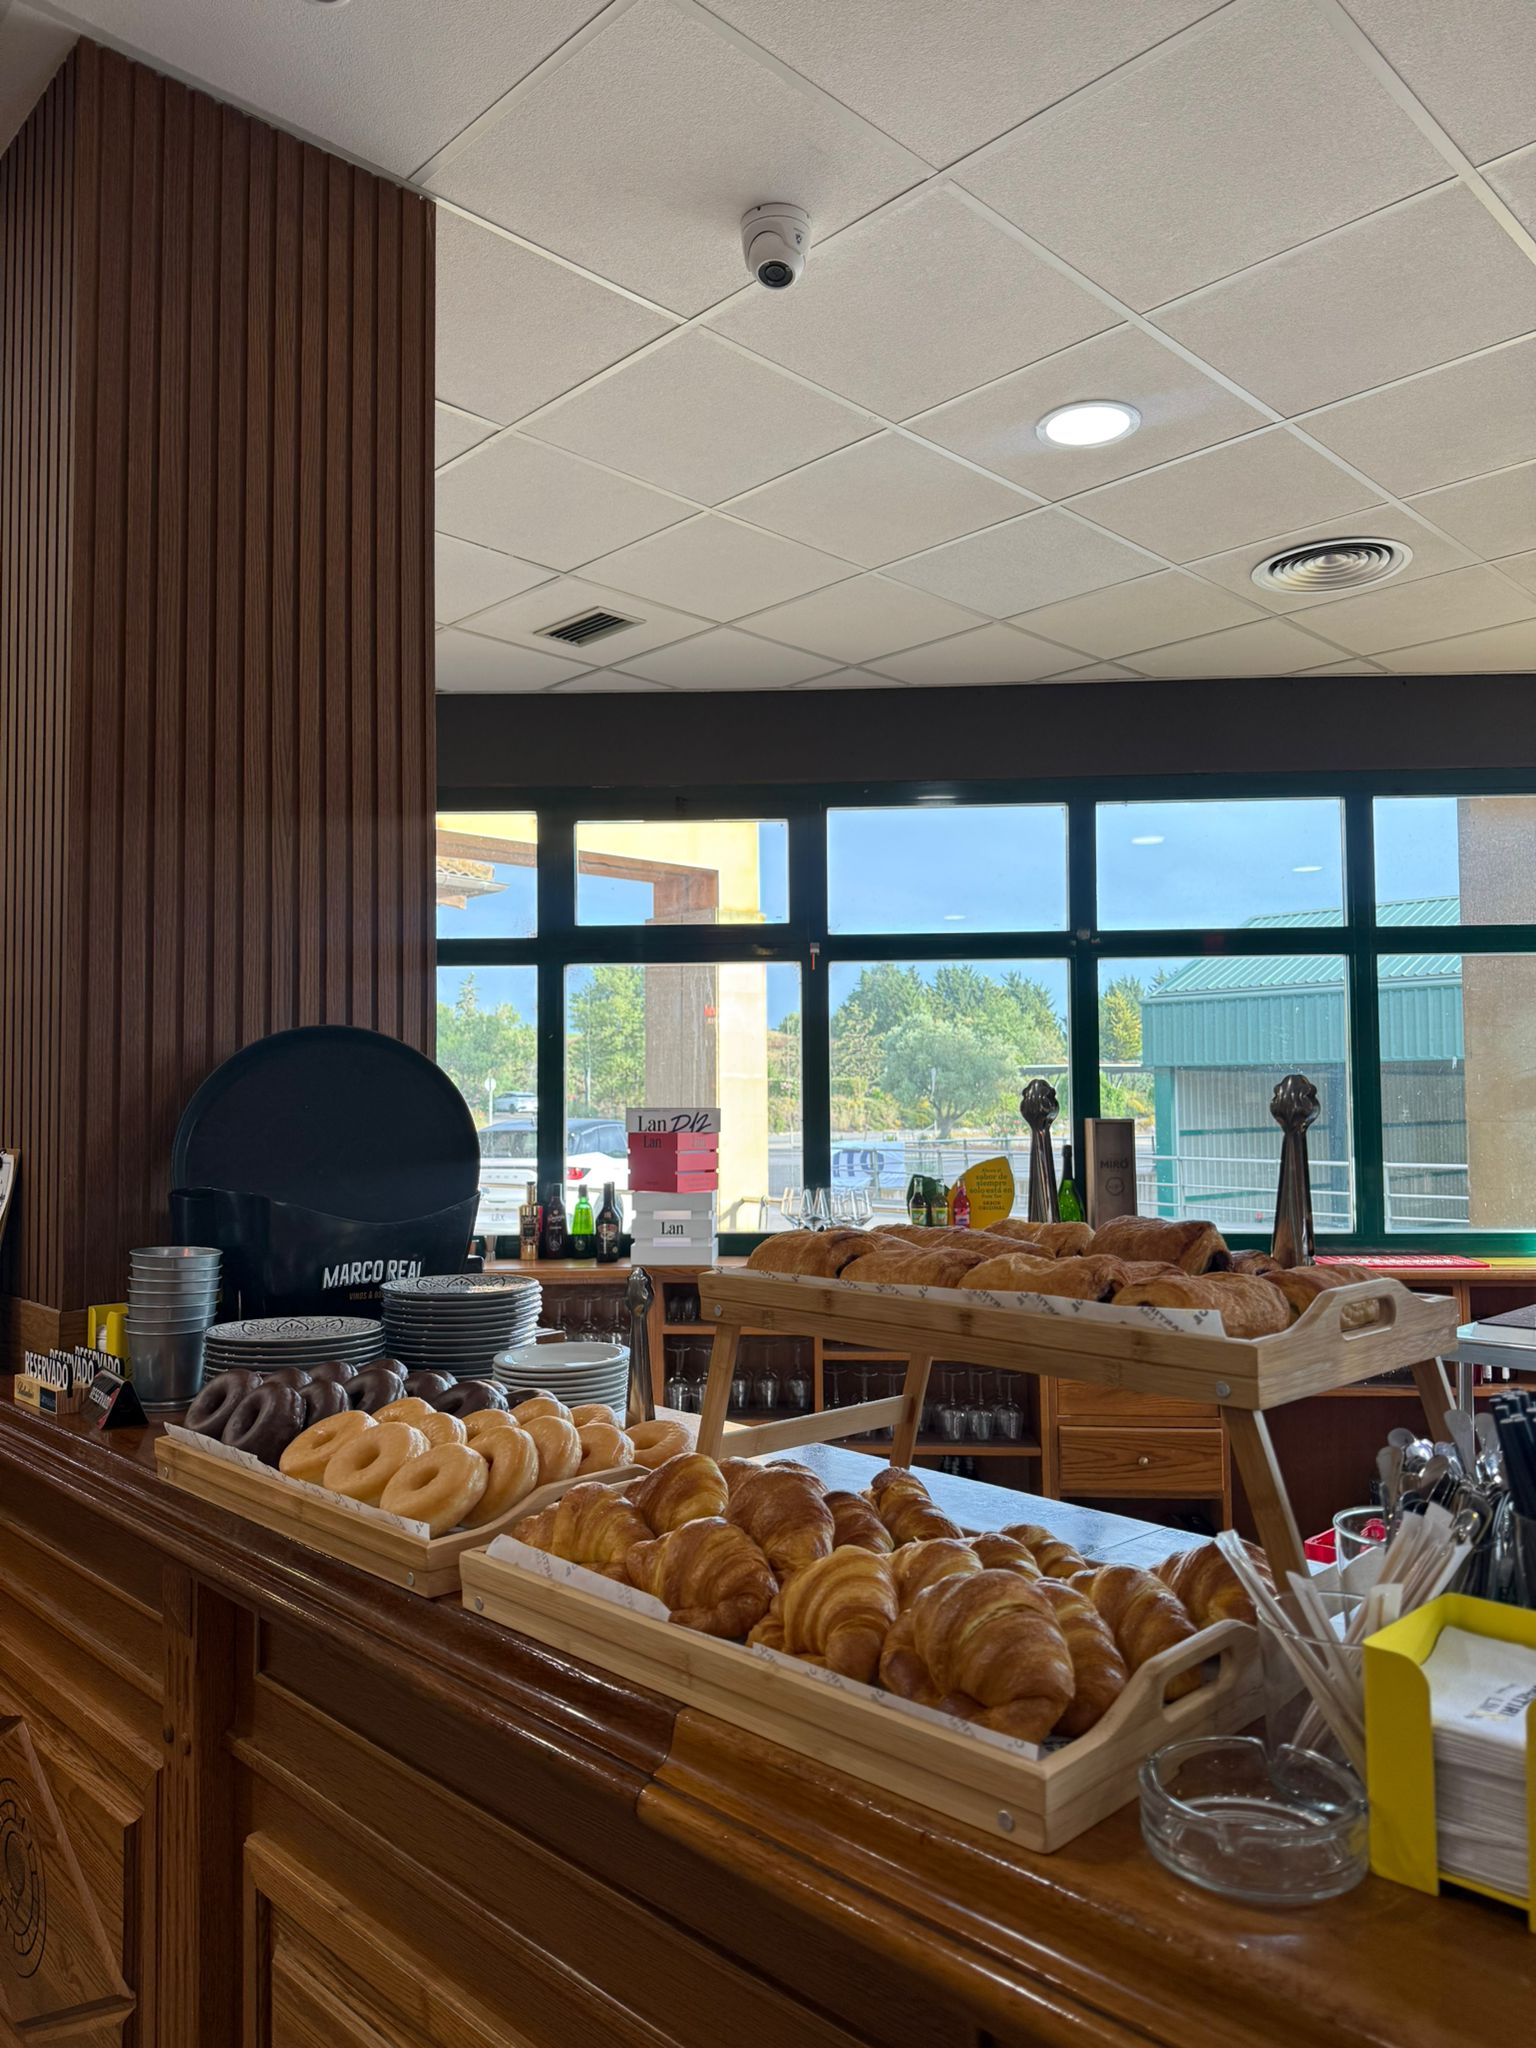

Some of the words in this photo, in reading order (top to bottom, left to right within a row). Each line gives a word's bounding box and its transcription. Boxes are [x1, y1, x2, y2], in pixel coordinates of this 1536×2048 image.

[638, 1115, 667, 1132] Lan
[643, 1136, 662, 1149] Lan
[661, 1221, 684, 1235] Lan
[322, 1259, 384, 1290] MARCO
[25, 1351, 69, 1390] RESERVADO
